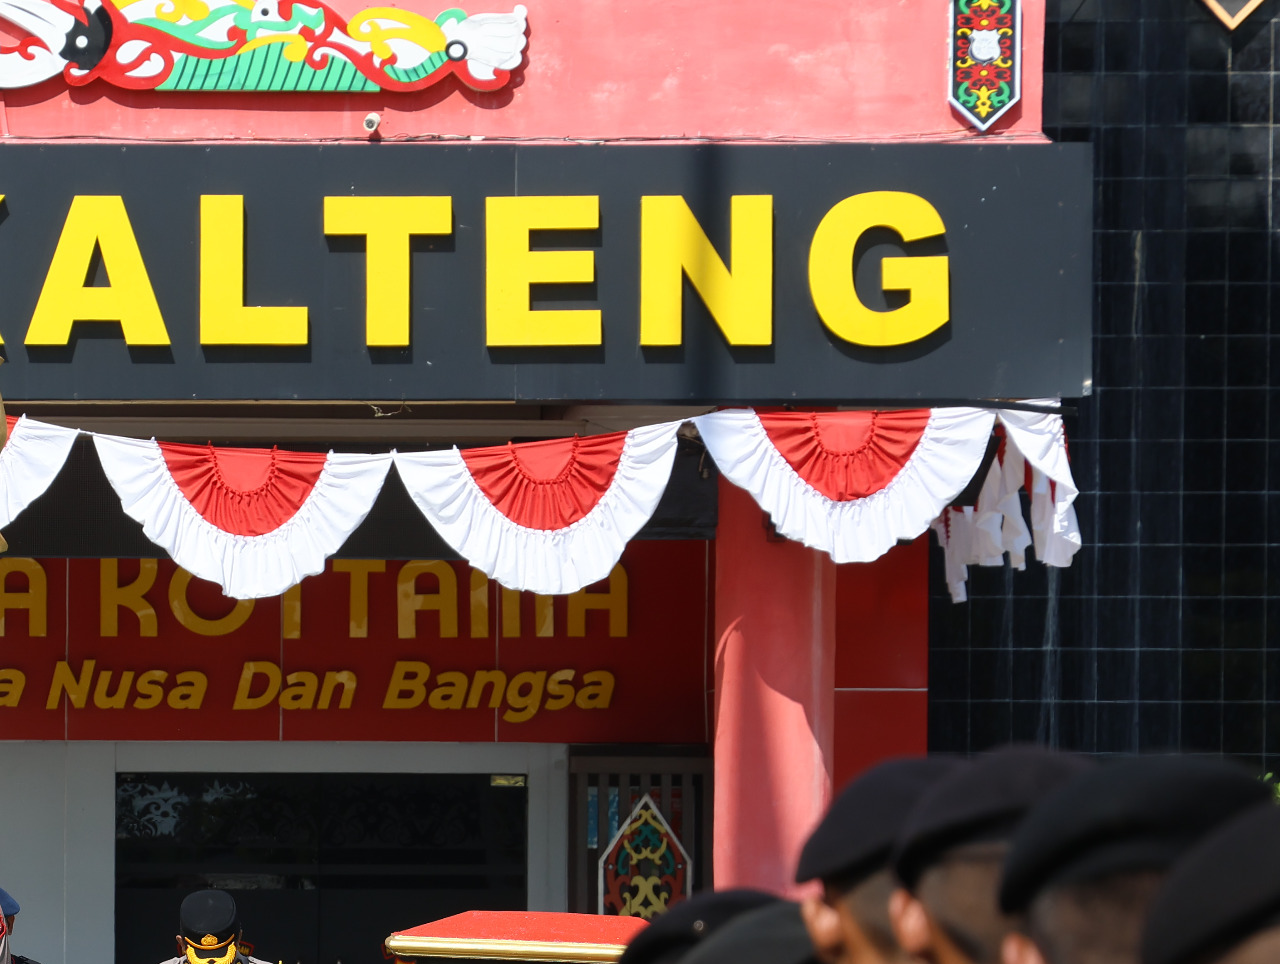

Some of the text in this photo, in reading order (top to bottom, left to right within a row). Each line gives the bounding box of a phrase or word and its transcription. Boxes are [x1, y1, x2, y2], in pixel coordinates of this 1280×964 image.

[45, 658, 209, 710] Nusa
[232, 660, 357, 711] Dan
[382, 660, 615, 724] Bangsa
